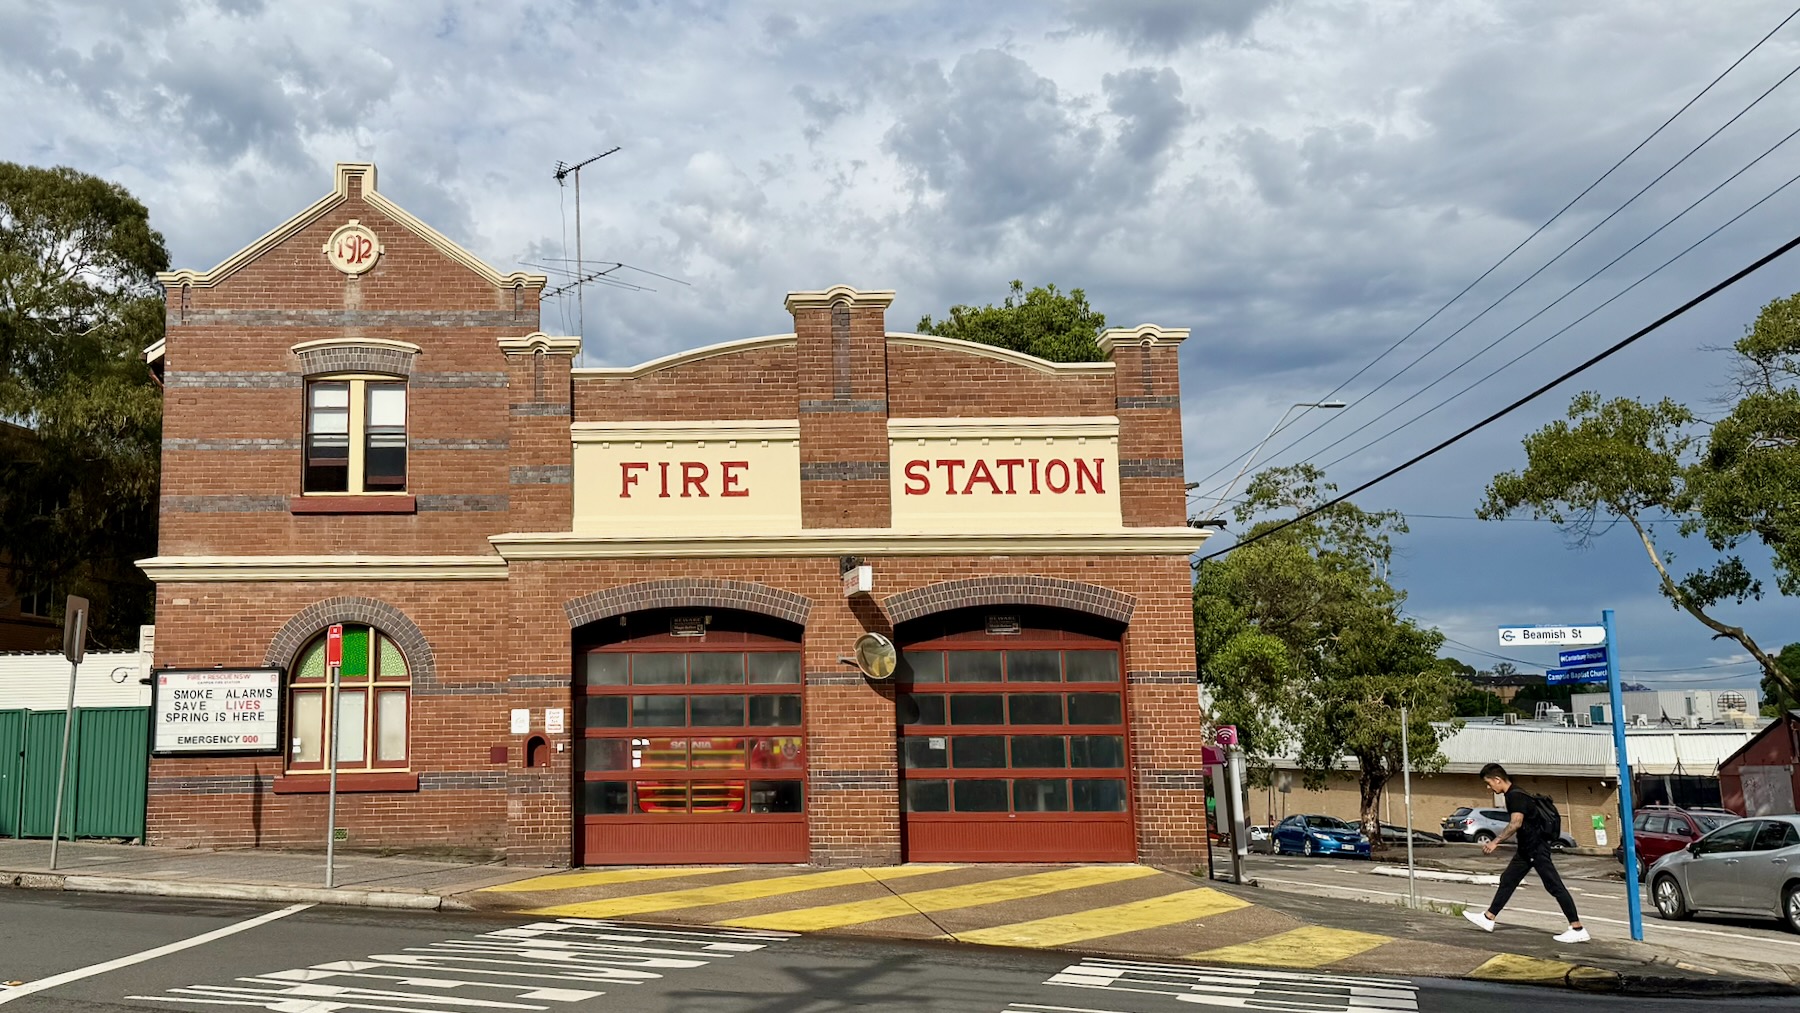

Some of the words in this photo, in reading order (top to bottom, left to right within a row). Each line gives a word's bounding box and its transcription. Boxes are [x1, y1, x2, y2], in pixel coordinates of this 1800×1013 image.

[337, 234, 372, 264] 1912
[619, 461, 749, 498] FIRE
[904, 458, 1105, 495] STATION
[1523, 629, 1566, 640] Beamish
[1571, 628, 1582, 639] St
[1547, 672, 1569, 681] Campsie
[1570, 670, 1589, 679] Baptist
[173, 689, 213, 700] SMOKE
[225, 688, 273, 699] ALARMS
[174, 700, 207, 711] SAVE
[225, 700, 261, 710] LIVES
[165, 712, 209, 723] SPRING
[215, 712, 227, 722] IS
[233, 711, 265, 722] HERE
[177, 735, 240, 745] EMERGENCY
[242, 735, 259, 744] 000
[670, 741, 712, 749] SCNIA
